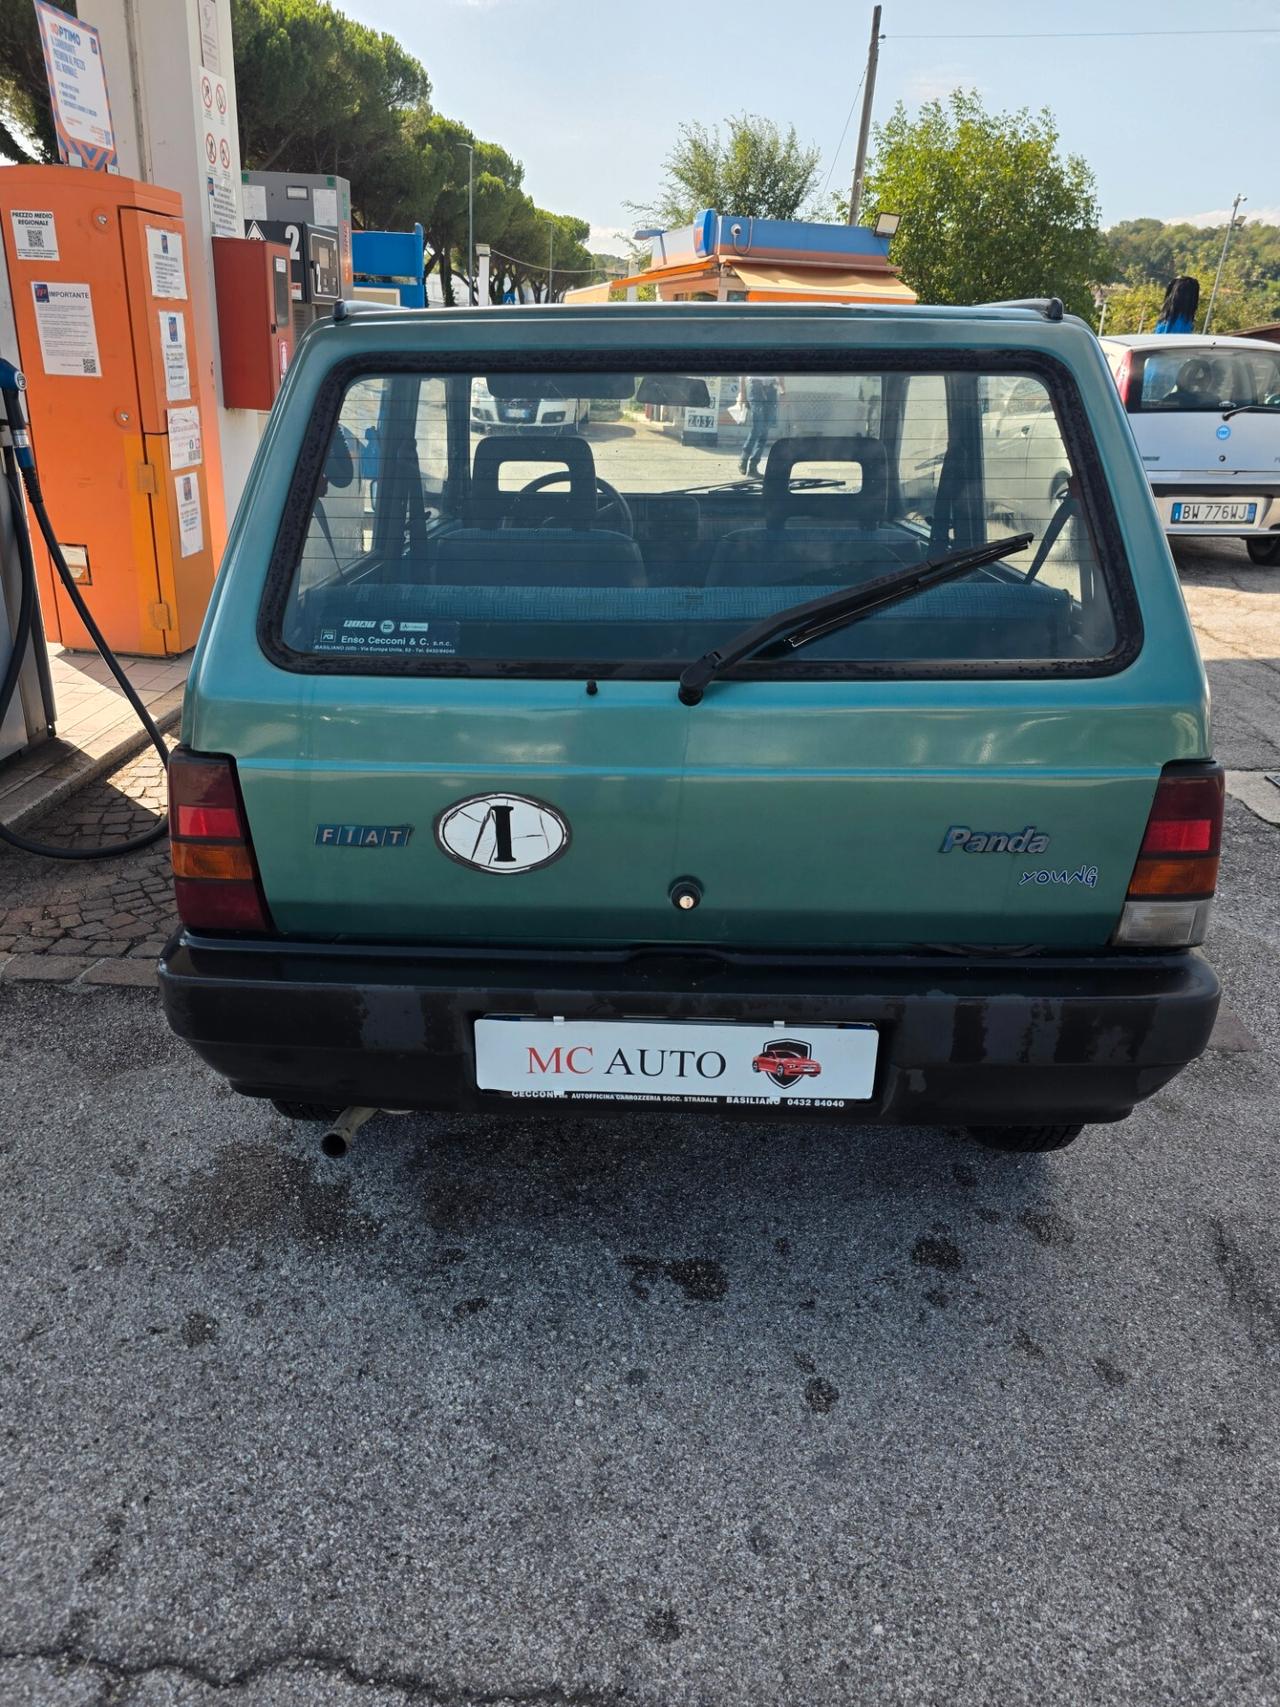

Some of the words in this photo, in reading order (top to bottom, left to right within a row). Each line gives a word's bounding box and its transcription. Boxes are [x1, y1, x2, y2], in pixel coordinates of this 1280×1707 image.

[285, 225, 300, 260] 2
[49, 291, 89, 299] IMPORTANTE
[1182, 505, 1200, 520] BW
[1205, 505, 1247, 520] 776WJ
[341, 635, 365, 644] Enso
[368, 636, 406, 645] Cecconi
[409, 637, 416, 646] &
[419, 637, 429, 646] C.
[320, 826, 404, 845] FIAT
[491, 804, 517, 863] I
[941, 825, 1051, 854] Panda
[525, 1046, 594, 1075] MC
[603, 1047, 727, 1079] AUTO
[571, 1092, 614, 1100] AUTOFFICINA
[616, 1093, 661, 1102] CARROZZERIA
[787, 1098, 811, 1106] 0432
[814, 1099, 845, 1107] 84040
